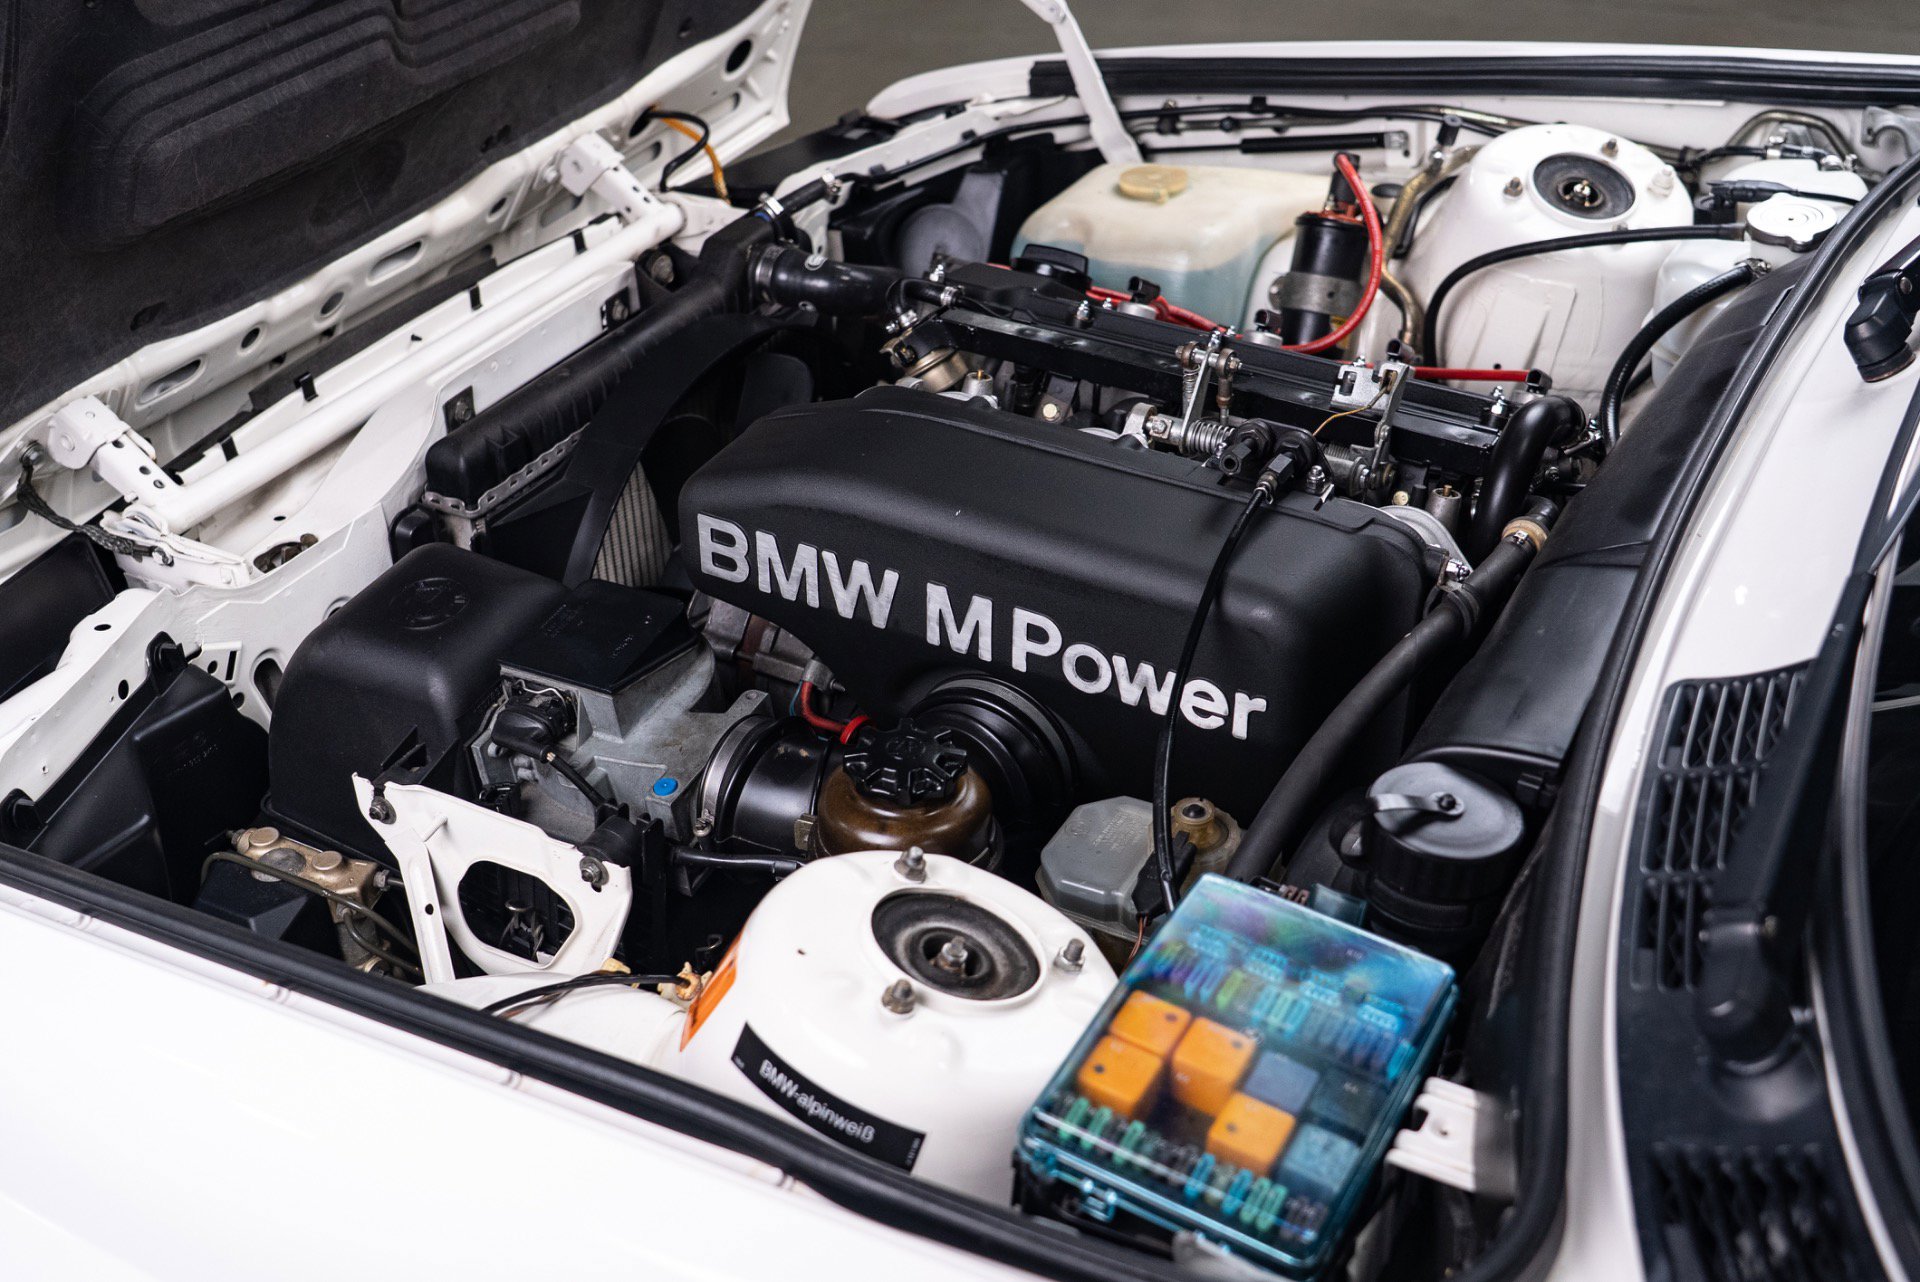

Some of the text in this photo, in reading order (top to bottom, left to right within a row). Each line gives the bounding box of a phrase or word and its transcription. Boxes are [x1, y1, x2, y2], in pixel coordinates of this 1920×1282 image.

[697, 513, 1268, 740] BMW M Power
